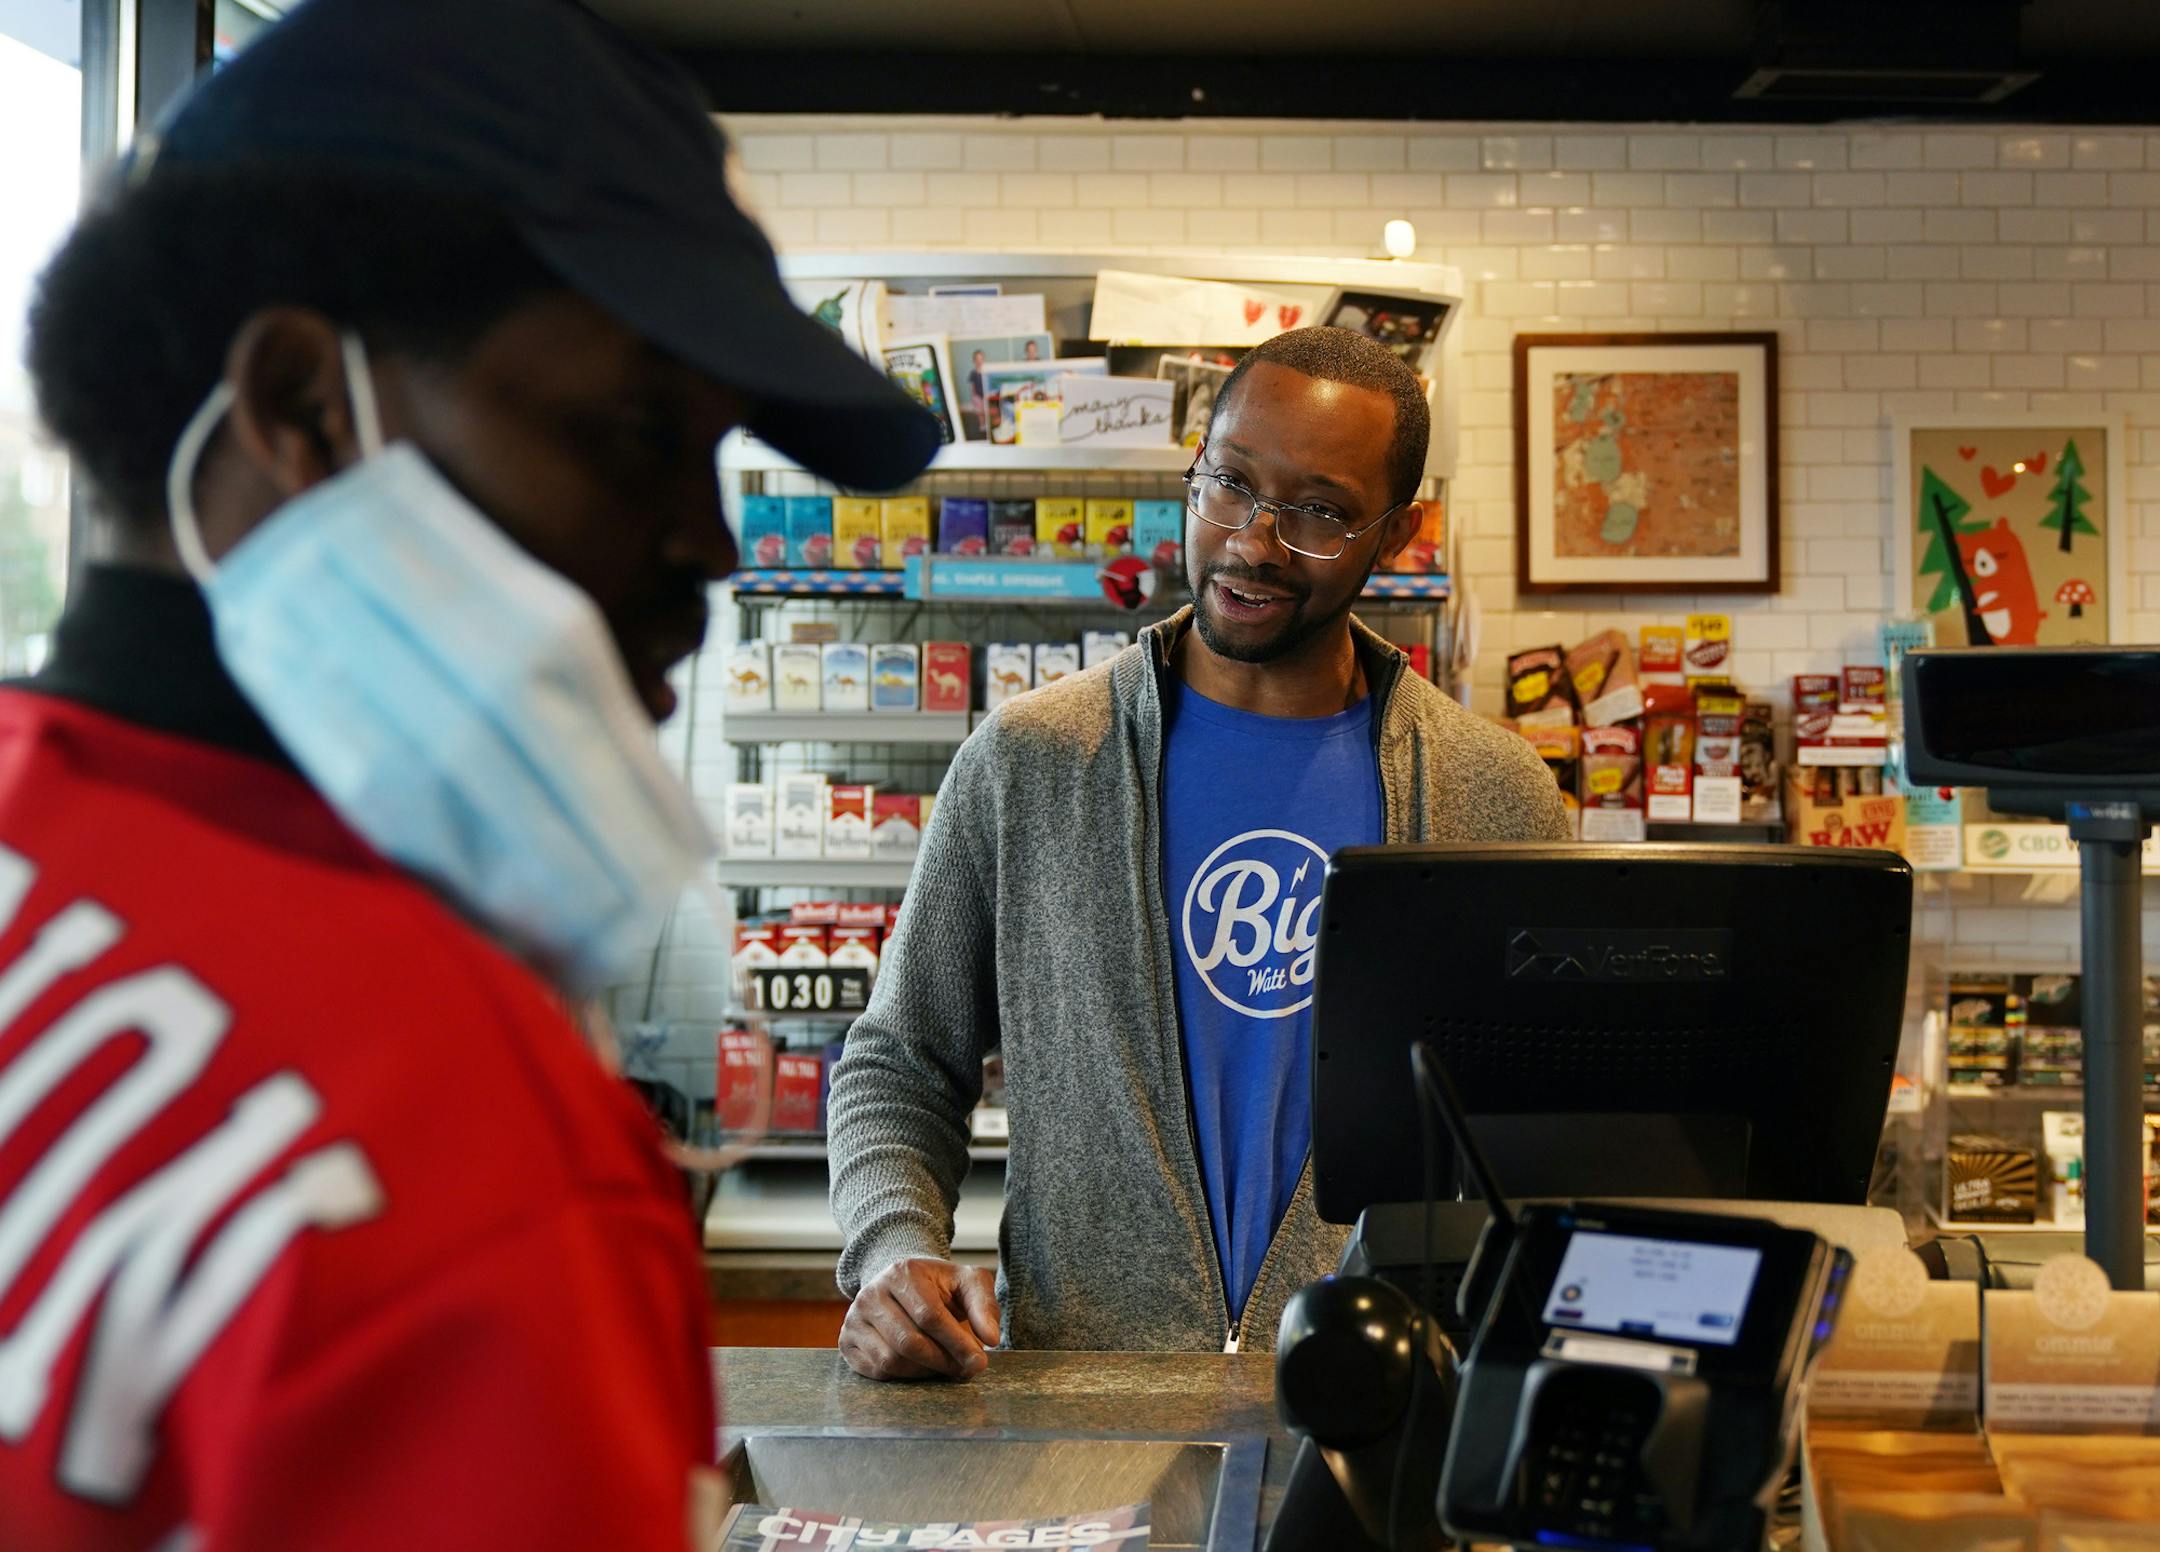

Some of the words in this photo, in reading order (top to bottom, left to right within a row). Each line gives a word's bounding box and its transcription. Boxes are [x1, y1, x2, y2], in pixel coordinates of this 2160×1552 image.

[1808, 821, 1892, 847] RAW
[2018, 834, 2060, 853] CBD
[1247, 966, 1287, 997] Watt
[758, 1515, 900, 1546] CITY
[906, 1522, 1112, 1548] PAGES
